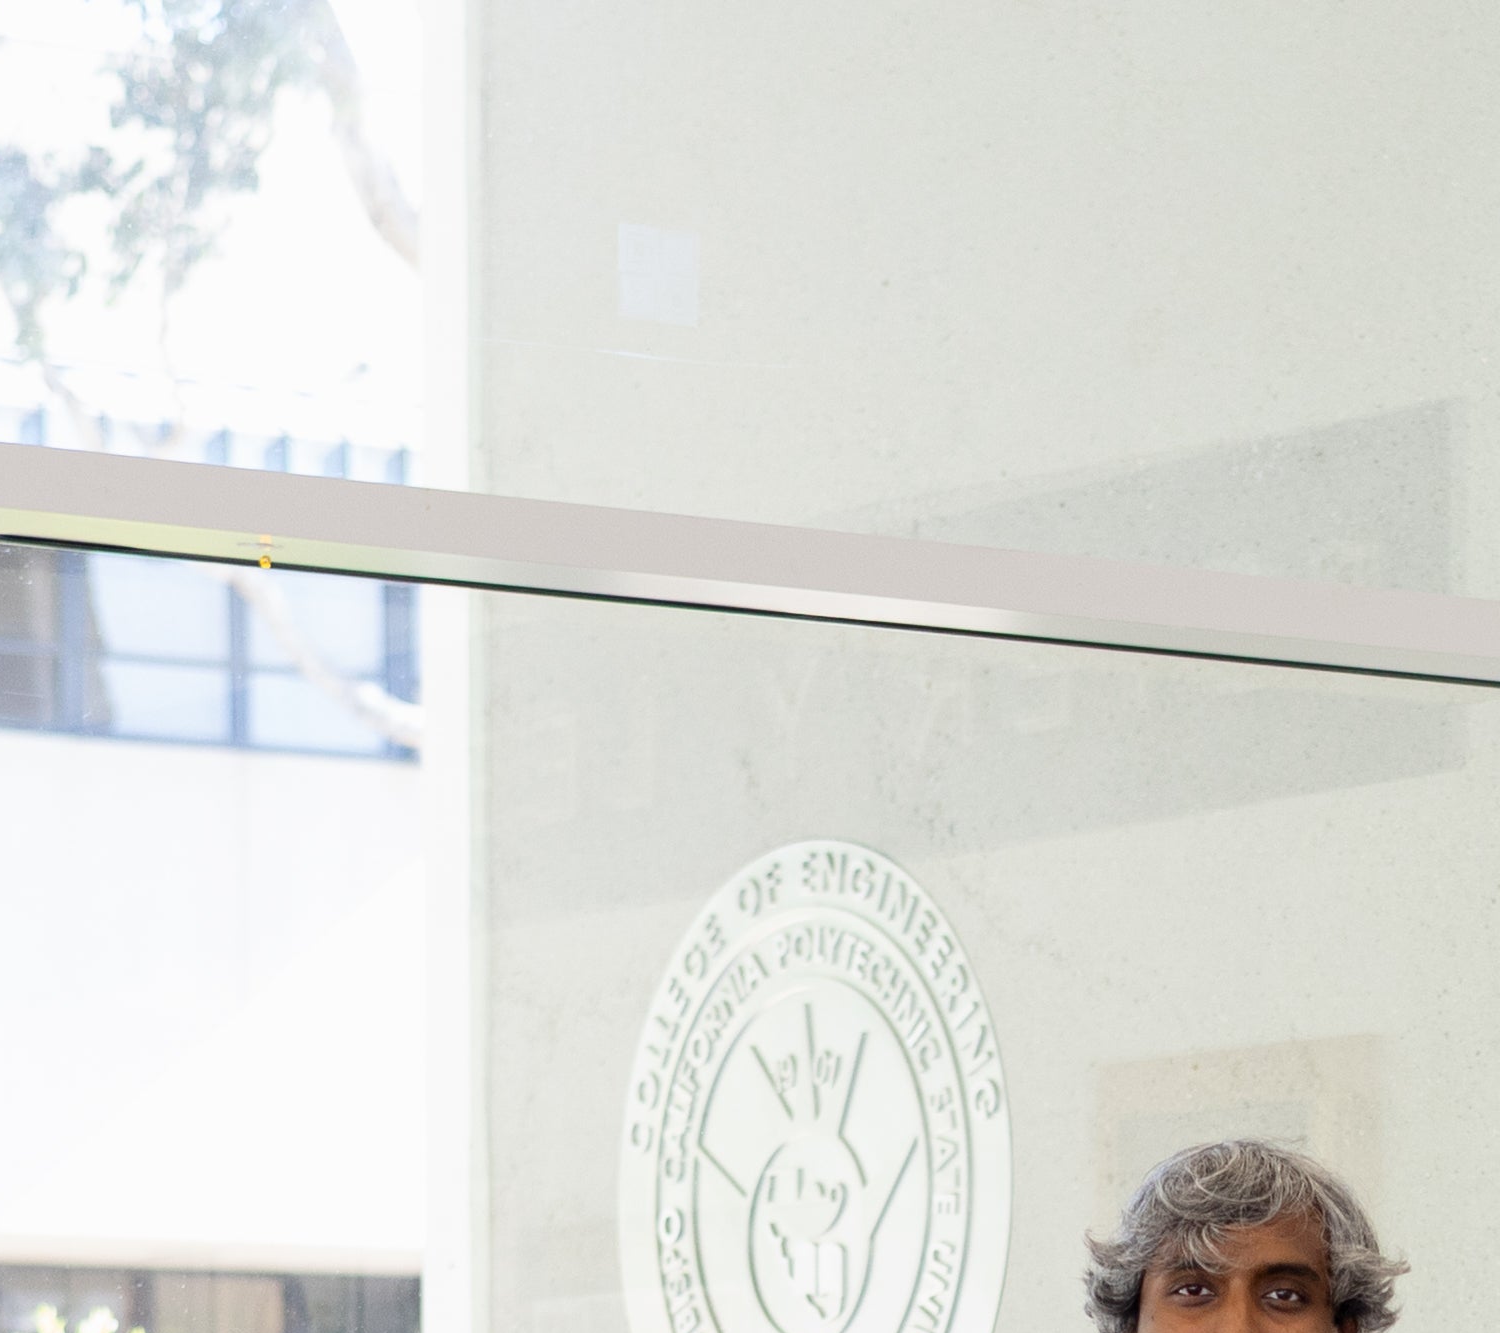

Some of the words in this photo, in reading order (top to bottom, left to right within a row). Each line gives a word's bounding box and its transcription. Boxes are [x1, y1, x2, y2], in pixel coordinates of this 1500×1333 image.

[631, 912, 728, 1153] COLLEGE
[737, 860, 782, 918] OF
[801, 850, 1002, 1120] ENGINEERING
[778, 925, 944, 1074] POLYTECHNIC
[929, 1086, 962, 1217] STATE
